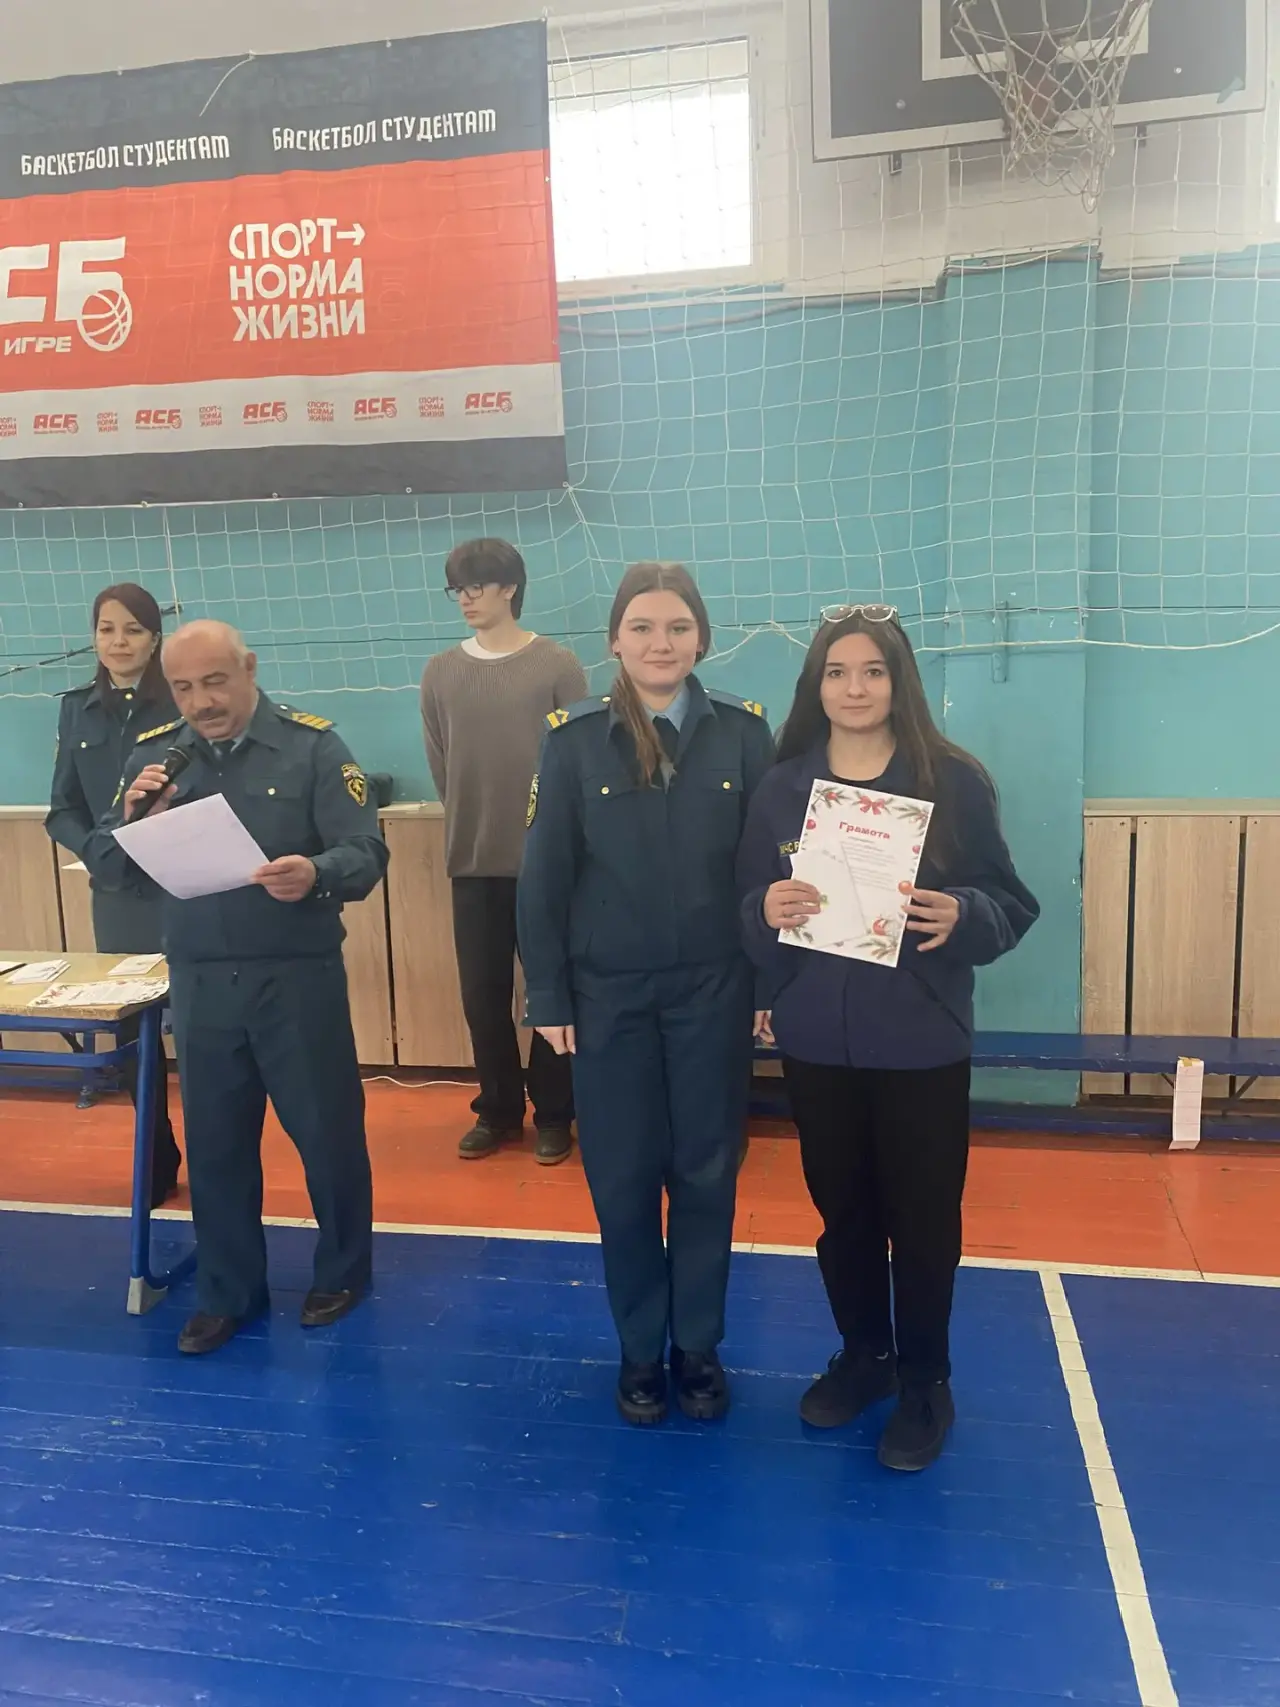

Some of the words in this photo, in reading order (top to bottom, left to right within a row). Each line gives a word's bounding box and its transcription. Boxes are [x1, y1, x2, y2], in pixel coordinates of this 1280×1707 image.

[272, 120, 377, 151] БАСКЕТБОЛ
[382, 108, 497, 143] СТУДЕНТАМ
[20, 145, 120, 176] БАСКЕТБОЛ
[123, 135, 230, 168] СТУДЕНТАМ
[228, 217, 338, 260] СПОРТ
[229, 257, 364, 301] НОРМА
[231, 298, 366, 342] ЖИЗНИ
[3, 335, 72, 356] ИГРЕ
[243, 401, 287, 419] АСБ
[354, 397, 396, 415] АСБ
[464, 391, 512, 410] АСБ
[33, 413, 78, 429] АСБ
[135, 409, 181, 425] АСБ
[838, 821, 891, 840] Грамота
